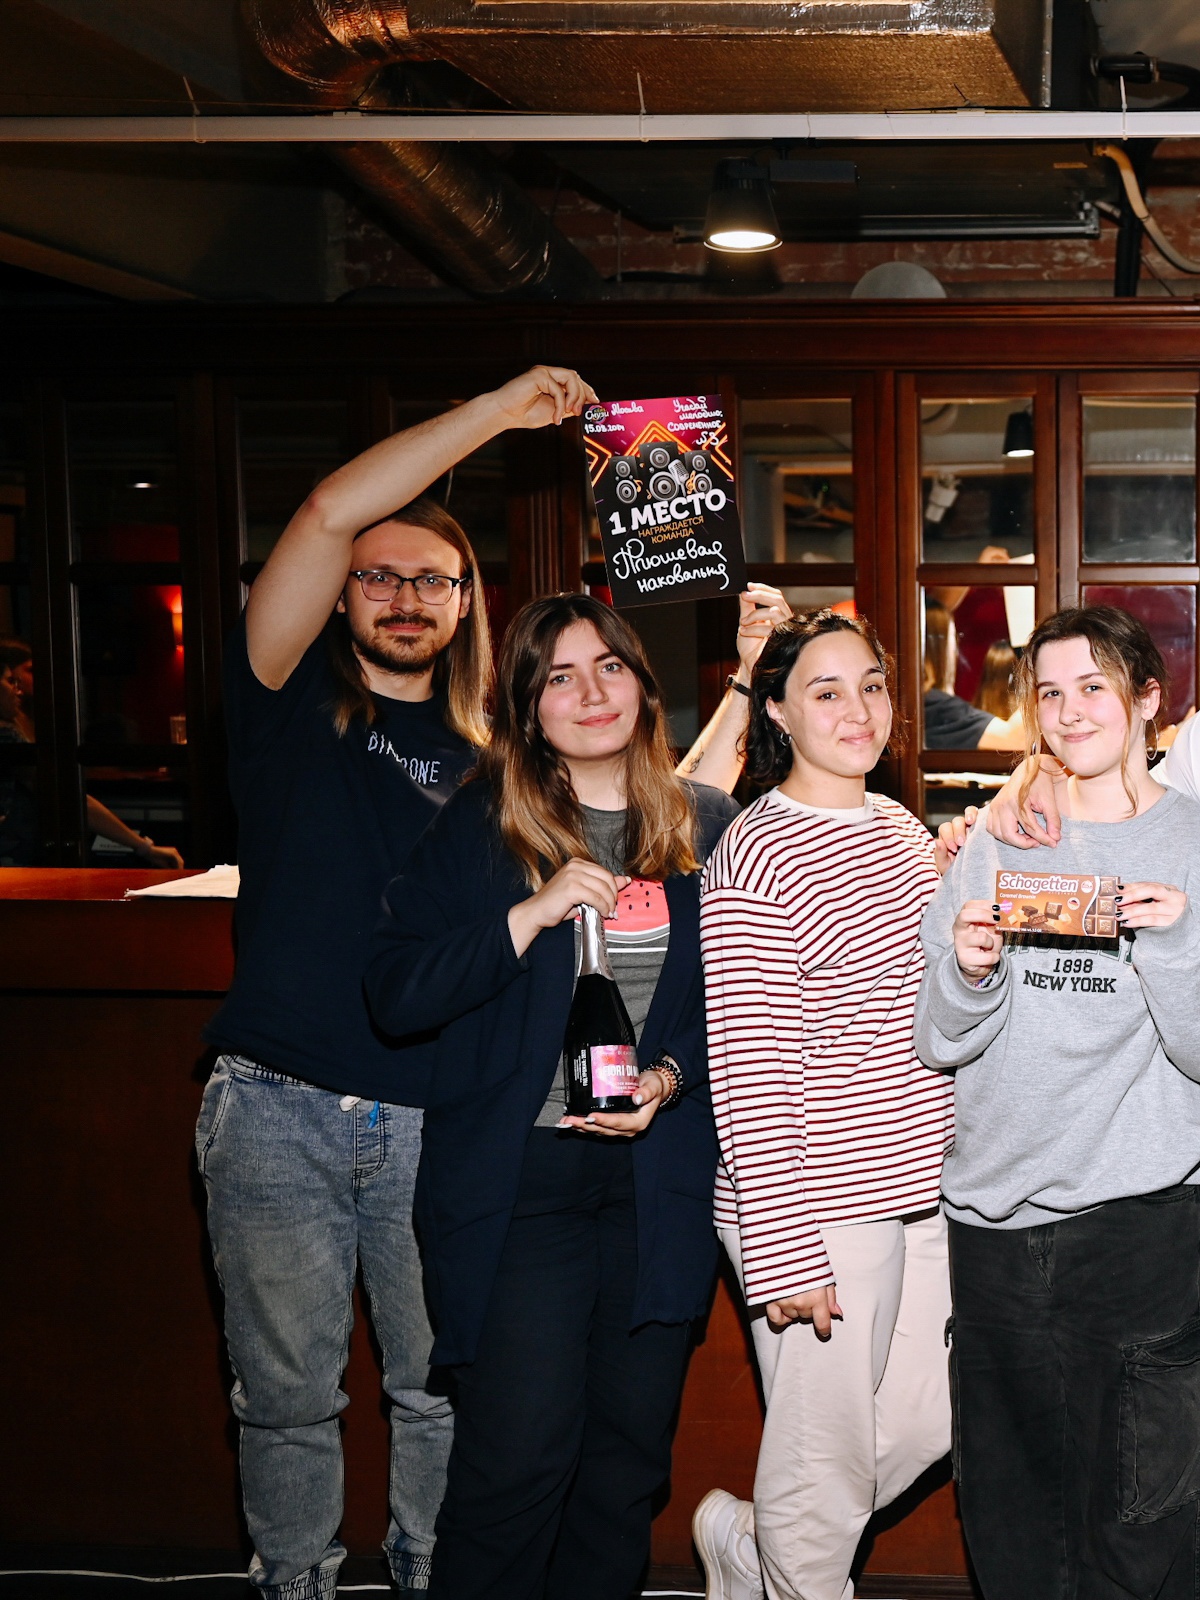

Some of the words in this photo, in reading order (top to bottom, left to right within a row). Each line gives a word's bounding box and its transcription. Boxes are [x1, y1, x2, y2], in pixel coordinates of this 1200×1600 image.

[608, 511, 627, 536] 1
[630, 488, 727, 531] МЕСТО
[638, 515, 705, 538] НАГРАЖДАЕТСЯ
[651, 527, 695, 545] КОМАНДА
[999, 872, 1079, 894] Schogetten
[1053, 958, 1093, 974] 1898
[1023, 970, 1067, 991] NEW
[1070, 976, 1117, 994] YORK
